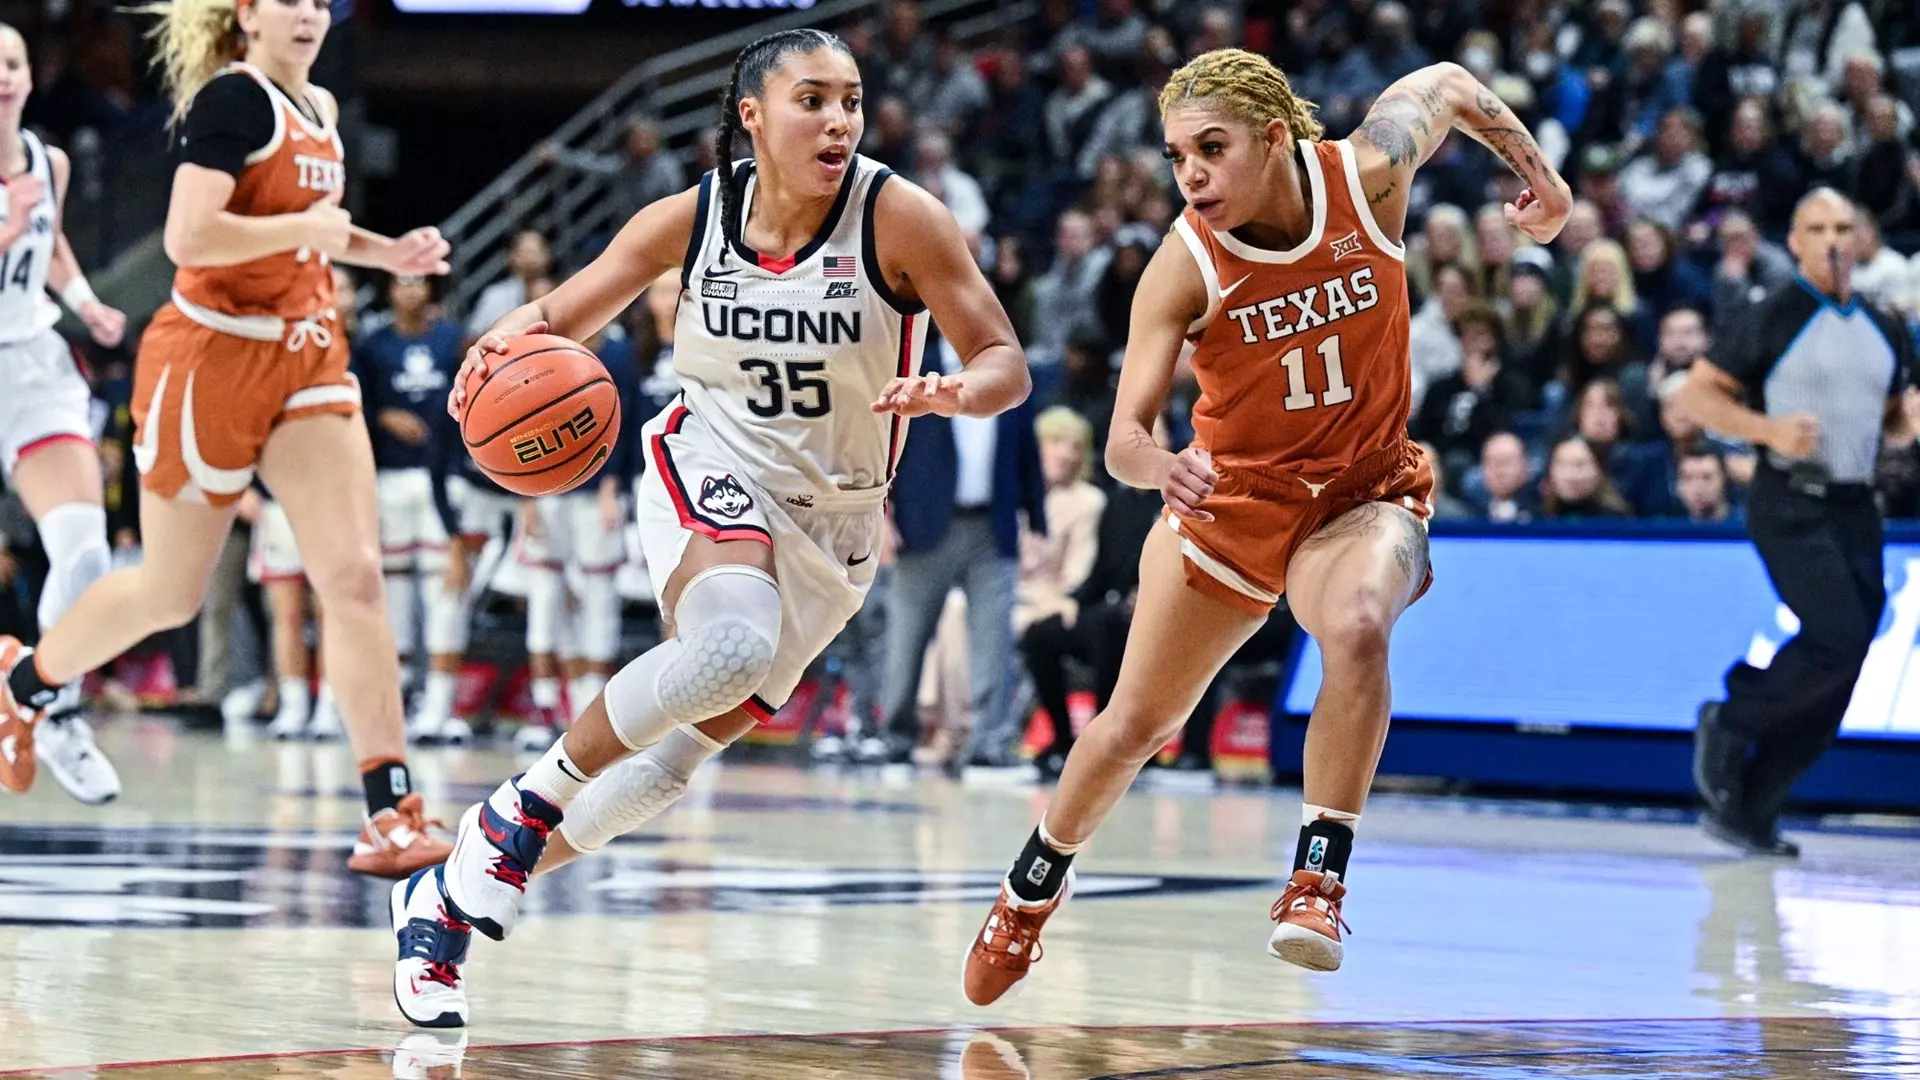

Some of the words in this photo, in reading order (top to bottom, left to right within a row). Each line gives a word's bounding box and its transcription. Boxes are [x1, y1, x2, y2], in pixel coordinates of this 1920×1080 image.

[828, 282, 853, 290] BIG
[1227, 265, 1379, 344] TEXAS
[703, 302, 860, 344] UCONN
[739, 358, 831, 418] 35
[1280, 334, 1353, 411] 11
[512, 406, 598, 465] ELITE
